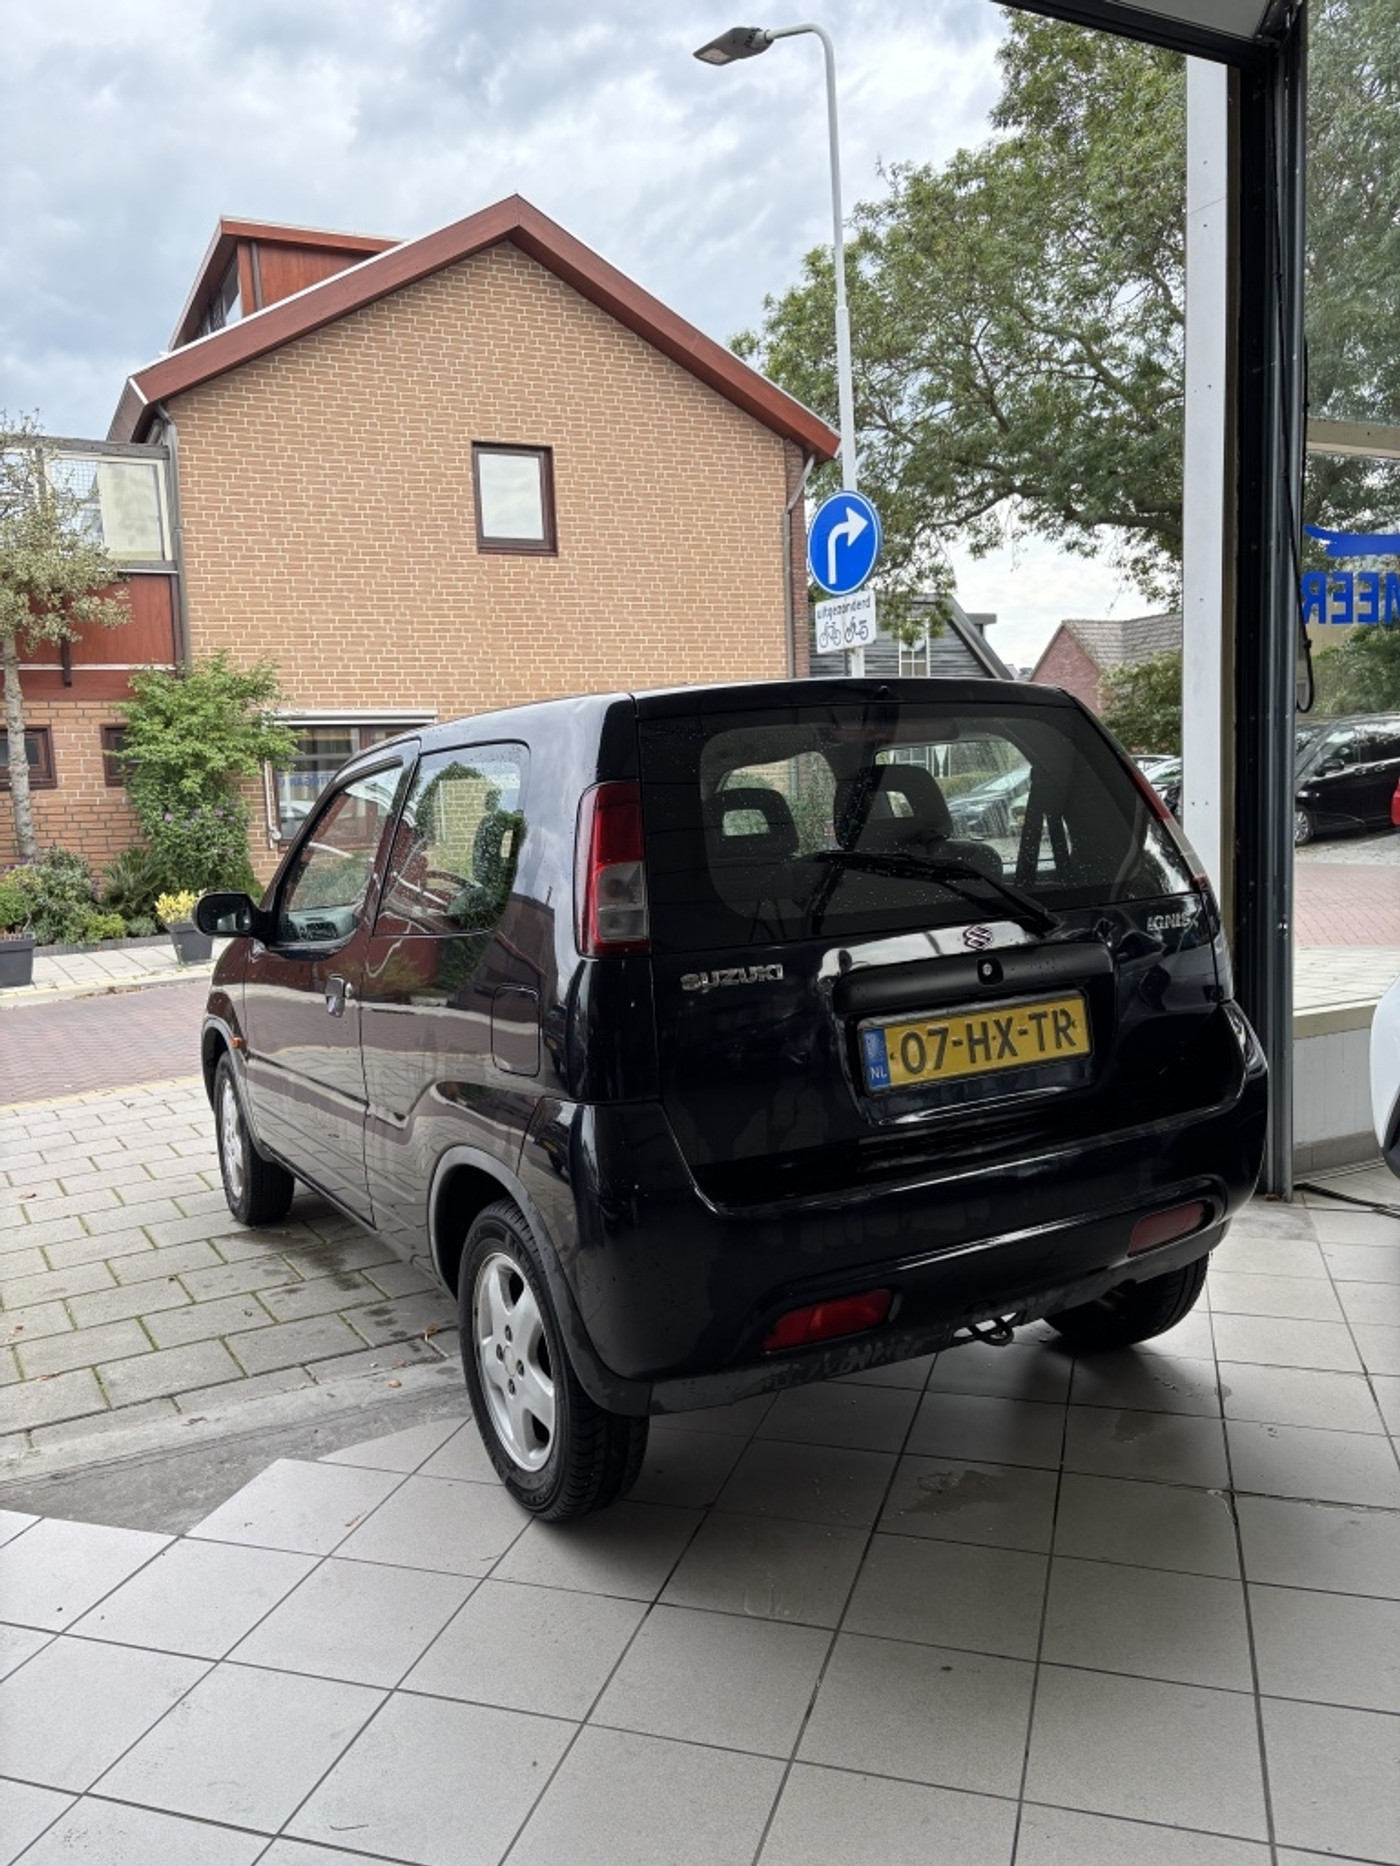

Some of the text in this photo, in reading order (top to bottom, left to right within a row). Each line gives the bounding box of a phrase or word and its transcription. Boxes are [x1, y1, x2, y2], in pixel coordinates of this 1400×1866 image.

[1146, 913, 1192, 931] IGNIS
[680, 964, 783, 991] SUZUKI
[871, 1008, 1077, 1080] NL 07-HX-TR
